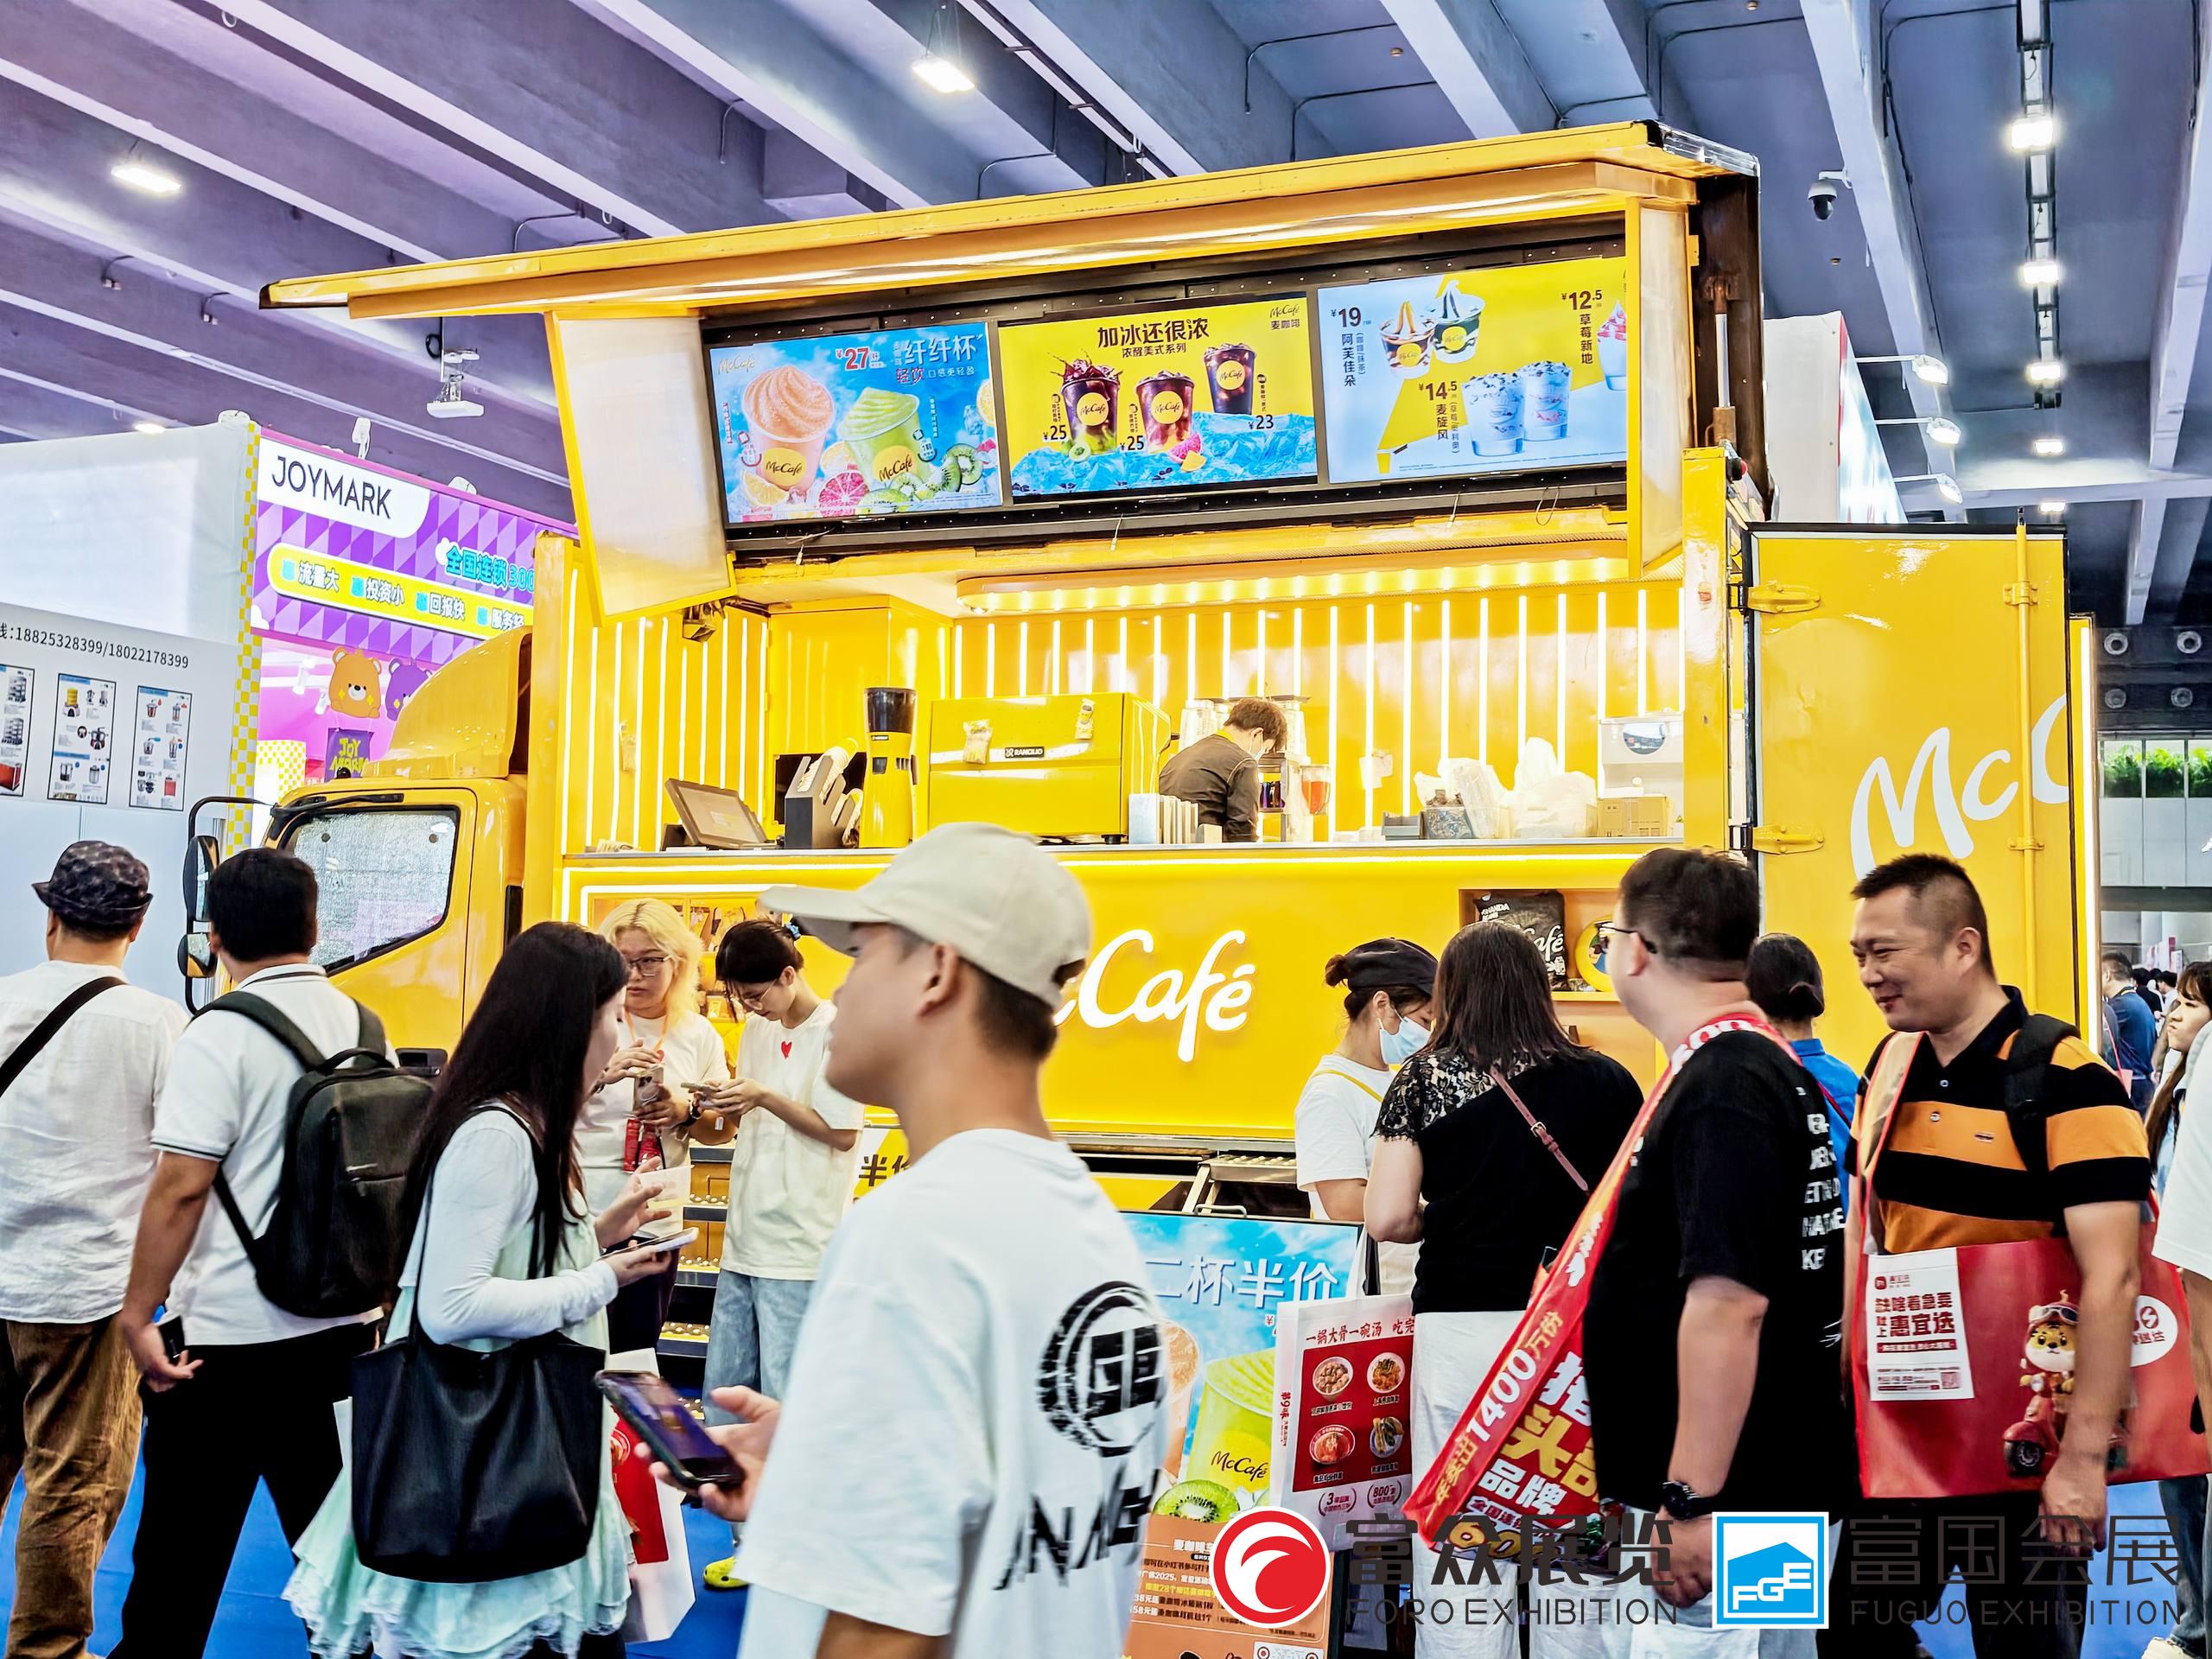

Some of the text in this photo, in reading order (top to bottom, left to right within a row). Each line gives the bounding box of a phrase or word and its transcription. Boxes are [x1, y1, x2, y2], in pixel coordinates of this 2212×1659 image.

[1097, 316, 1210, 348] 加冰还很浓
[1331, 307, 1362, 327] ¥19
[905, 334, 978, 365] 纤纤杯
[1122, 343, 1187, 359] 浓醒美式系列
[1580, 314, 1593, 365] 草莓新地
[1341, 333, 1357, 387] 阿芙佳朵
[1435, 404, 1449, 441] 麦旋风
[272, 455, 392, 519] JOYMARK
[297, 560, 340, 592] 流量大
[365, 578, 404, 607] 投资小
[429, 593, 466, 621] 回报快
[339, 738, 361, 758] JOY
[1053, 929, 1256, 1062] Café
[1145, 1255, 1339, 1309] 二杯半价
[1306, 1321, 1382, 1345] 一锅大骨一碗汤
[1890, 1311, 1955, 1338] 惠宜选
[1211, 1450, 1268, 1482] McCafé
[1478, 1458, 1568, 1515] 品牌
